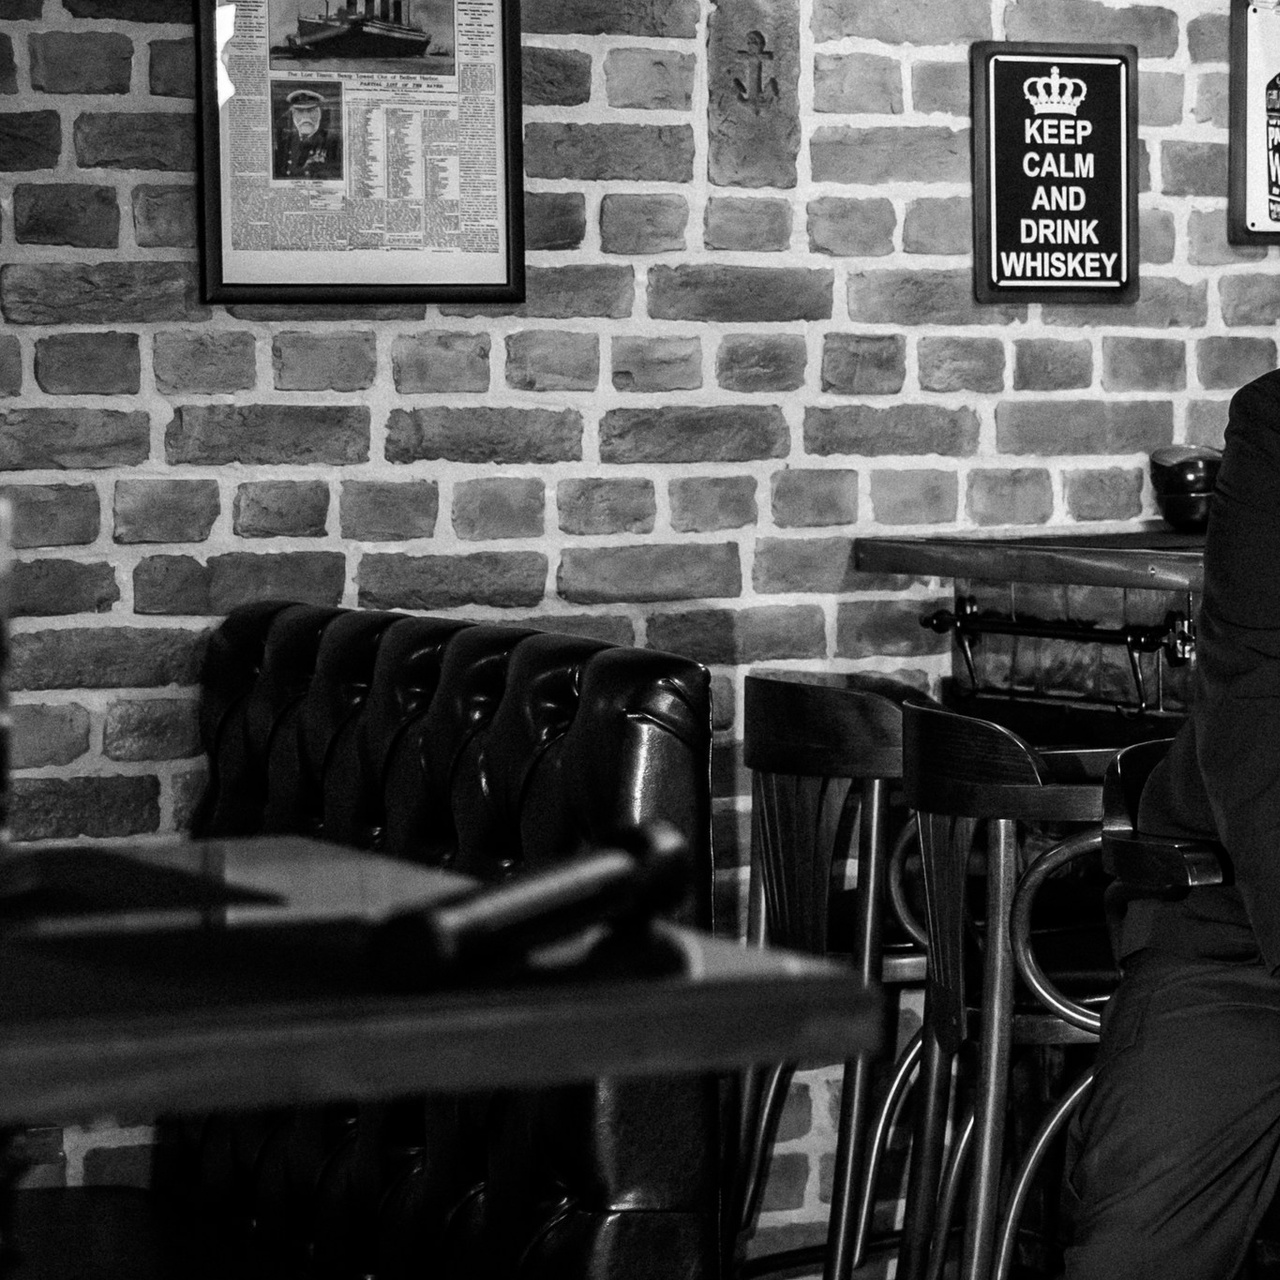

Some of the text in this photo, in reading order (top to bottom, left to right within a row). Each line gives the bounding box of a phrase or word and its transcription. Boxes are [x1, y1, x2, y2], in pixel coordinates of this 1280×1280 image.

[1025, 118, 1093, 145] KEEP
[1022, 151, 1094, 178] CALM
[1031, 186, 1086, 211] AND
[1020, 219, 1099, 244] DRINK
[1000, 251, 1118, 277] WHISKEY
